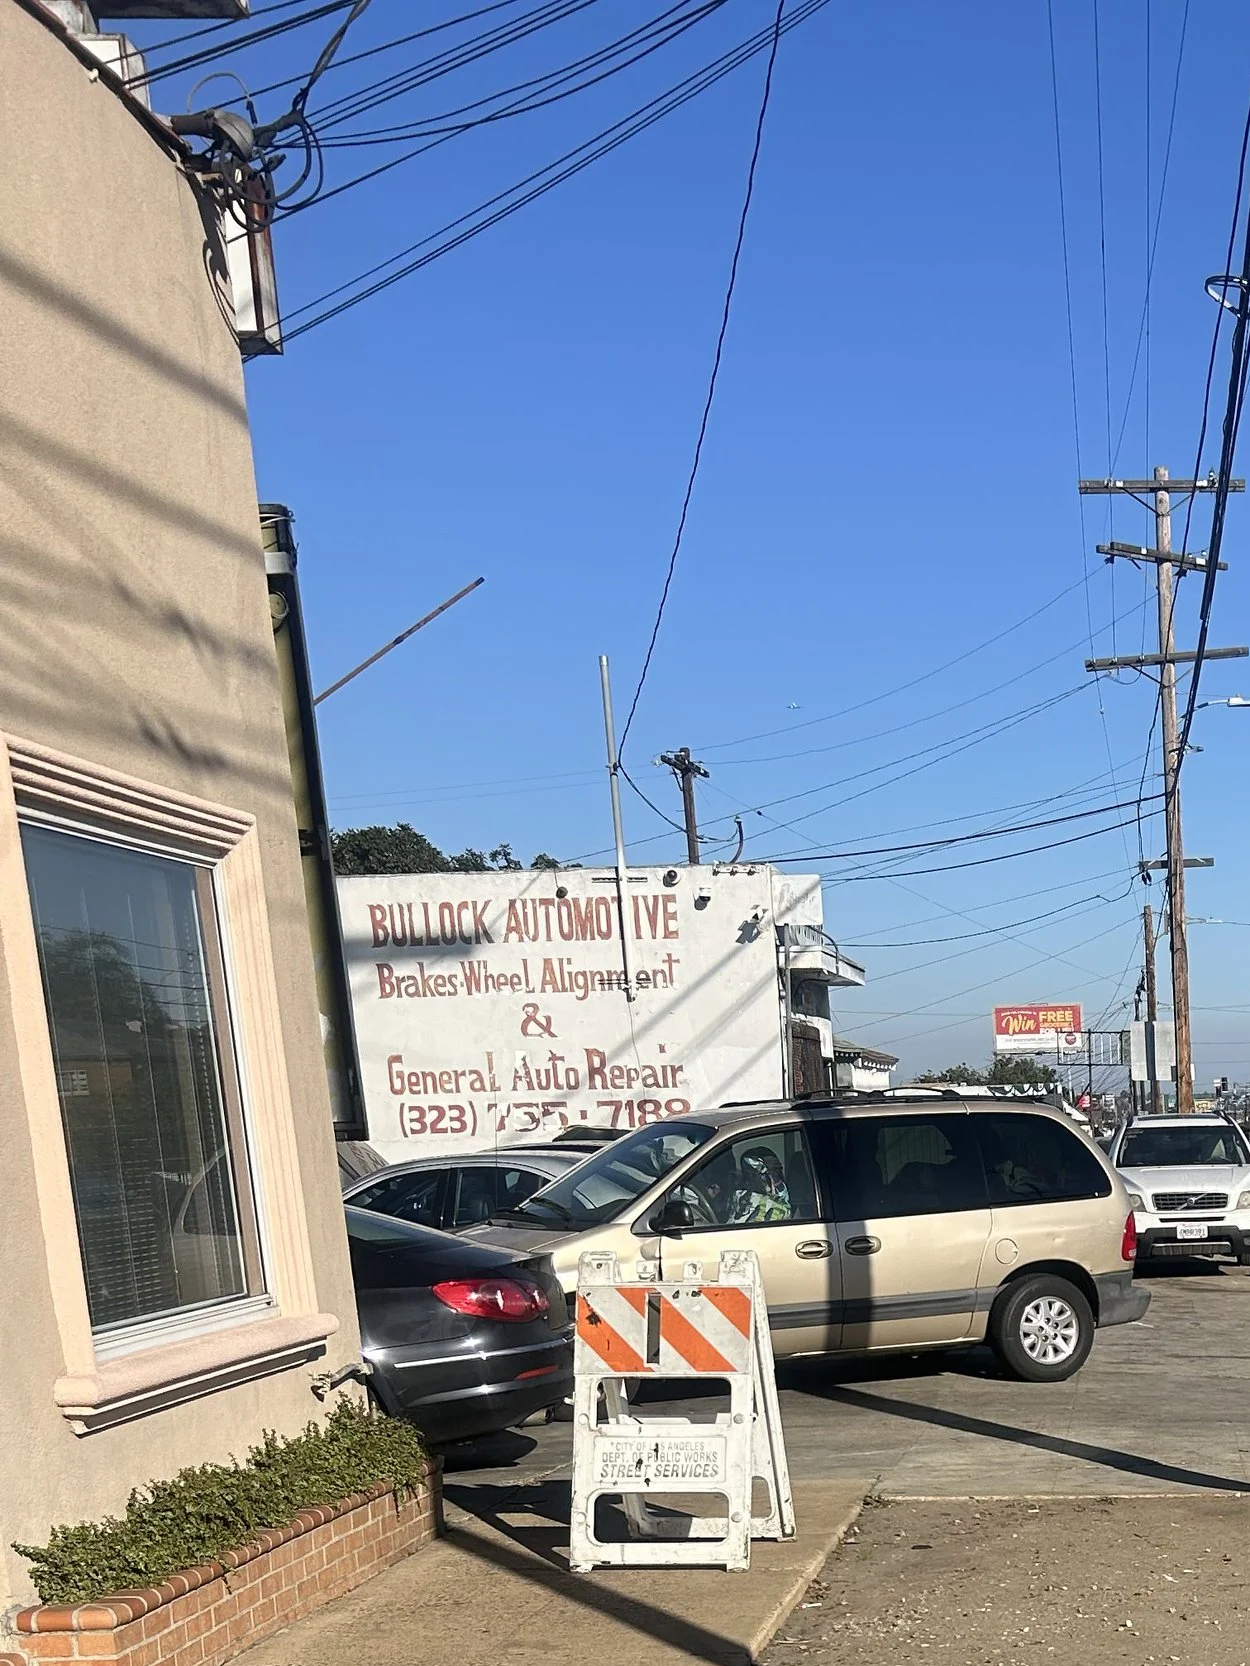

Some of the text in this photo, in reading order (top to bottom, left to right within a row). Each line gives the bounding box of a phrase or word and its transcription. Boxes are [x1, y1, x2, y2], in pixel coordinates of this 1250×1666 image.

[369, 899, 496, 948] BULLOCK
[539, 952, 681, 1001] Alignment
[520, 1002, 558, 1038] &
[1001, 1014, 1037, 1036] Win
[1039, 1011, 1073, 1022] FREE
[387, 1043, 685, 1096] General Auto Repair
[399, 1100, 478, 1138] (323)
[601, 1451, 629, 1463] DEPT.
[632, 1451, 644, 1463] OF
[684, 1451, 719, 1463] WORKS
[615, 1440, 705, 1451] CITY OF LS ANGELES
[600, 1463, 720, 1478] STREET SERVICES
